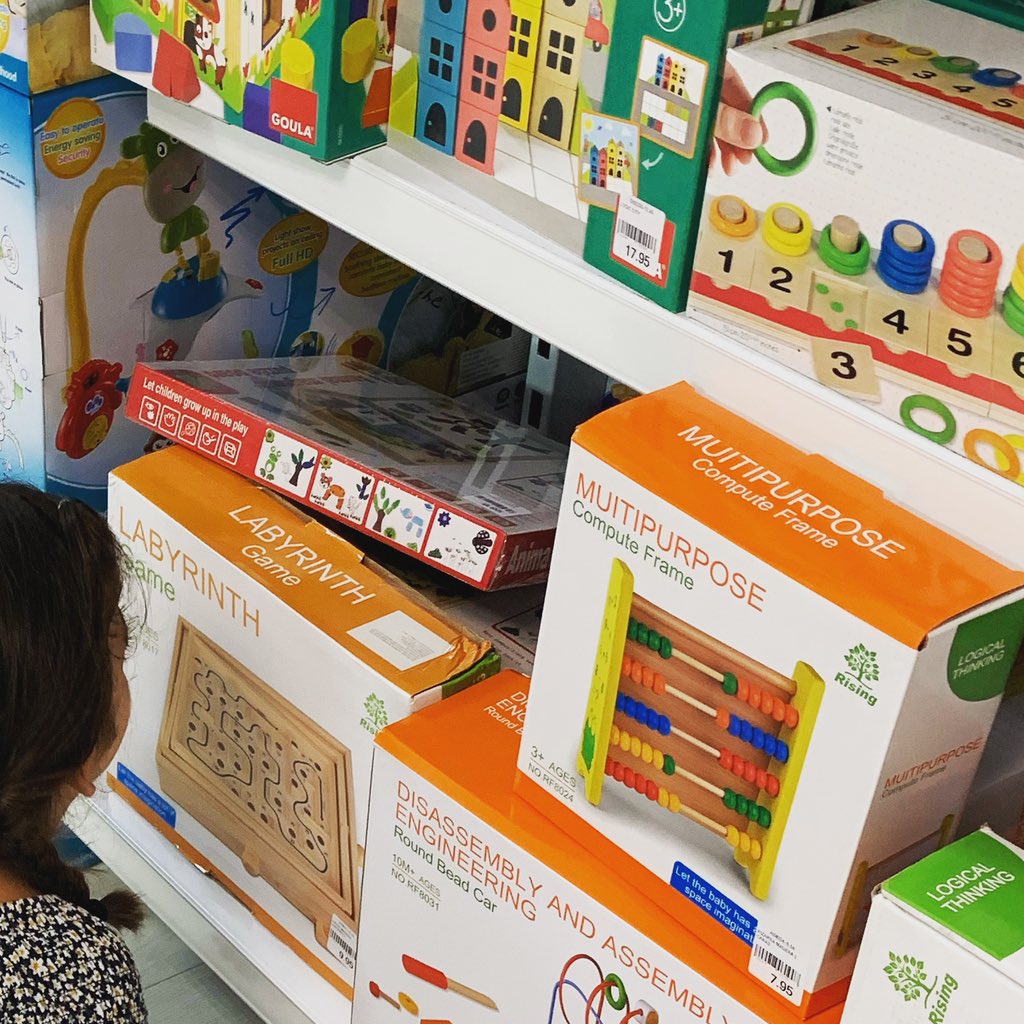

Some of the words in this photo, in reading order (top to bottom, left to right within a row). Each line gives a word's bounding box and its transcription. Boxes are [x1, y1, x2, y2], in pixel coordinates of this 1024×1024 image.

[874, 57, 900, 66] 2
[912, 70, 937, 79] 3
[952, 85, 975, 93] 4
[992, 98, 1018, 108] 5
[40, 131, 58, 141] Easy
[61, 127, 70, 135] to
[72, 114, 104, 132] operate
[271, 112, 312, 138] GOULA
[44, 140, 72, 154] Energy
[74, 131, 101, 146] saving
[58, 147, 90, 163] Security
[271, 251, 294, 270] Full
[295, 247, 314, 263] HD
[626, 245, 650, 268] 17.95
[718, 250, 734, 273] 1
[769, 266, 794, 293] 2
[882, 309, 909, 335] 4
[946, 328, 973, 357] 5
[831, 351, 857, 379] 3
[143, 377, 154, 390] Let
[155, 383, 183, 404] children
[183, 398, 202, 413] grow
[201, 406, 212, 419] up
[212, 408, 219, 421] in
[220, 412, 233, 428] the
[232, 420, 249, 437] play
[693, 458, 774, 512] Compute
[773, 508, 839, 550] Frame
[228, 505, 376, 606] LABYRINTH
[572, 500, 639, 555] Compute
[643, 545, 695, 592] Frame
[119, 506, 260, 637] LABYRINTH
[241, 544, 301, 586] Game
[952, 650, 1005, 680] THINKING
[957, 638, 1005, 666] LOGICAL
[834, 672, 878, 707] Rising
[483, 706, 519, 729] Round
[531, 746, 544, 760] 3+
[548, 762, 576, 788] AGES
[528, 763, 542, 777] NO
[543, 774, 574, 802] RF8024
[393, 825, 433, 865] Round
[437, 858, 469, 893] Bead
[473, 887, 498, 913] Car
[395, 802, 537, 922] ENGINEERING
[397, 780, 543, 898] DISASSEMBLY
[547, 895, 596, 940] AND
[391, 868, 406, 884] NO
[407, 880, 440, 911] RF8031
[392, 853, 415, 875] 10M+
[418, 876, 441, 897] AGES
[926, 862, 996, 902] LOGICAL
[675, 865, 690, 883] Let
[692, 876, 707, 896] the
[708, 890, 732, 916] baby
[733, 908, 751, 928] has
[684, 886, 712, 912] space
[940, 870, 1016, 913] THINKING
[771, 973, 794, 997] 7.95
